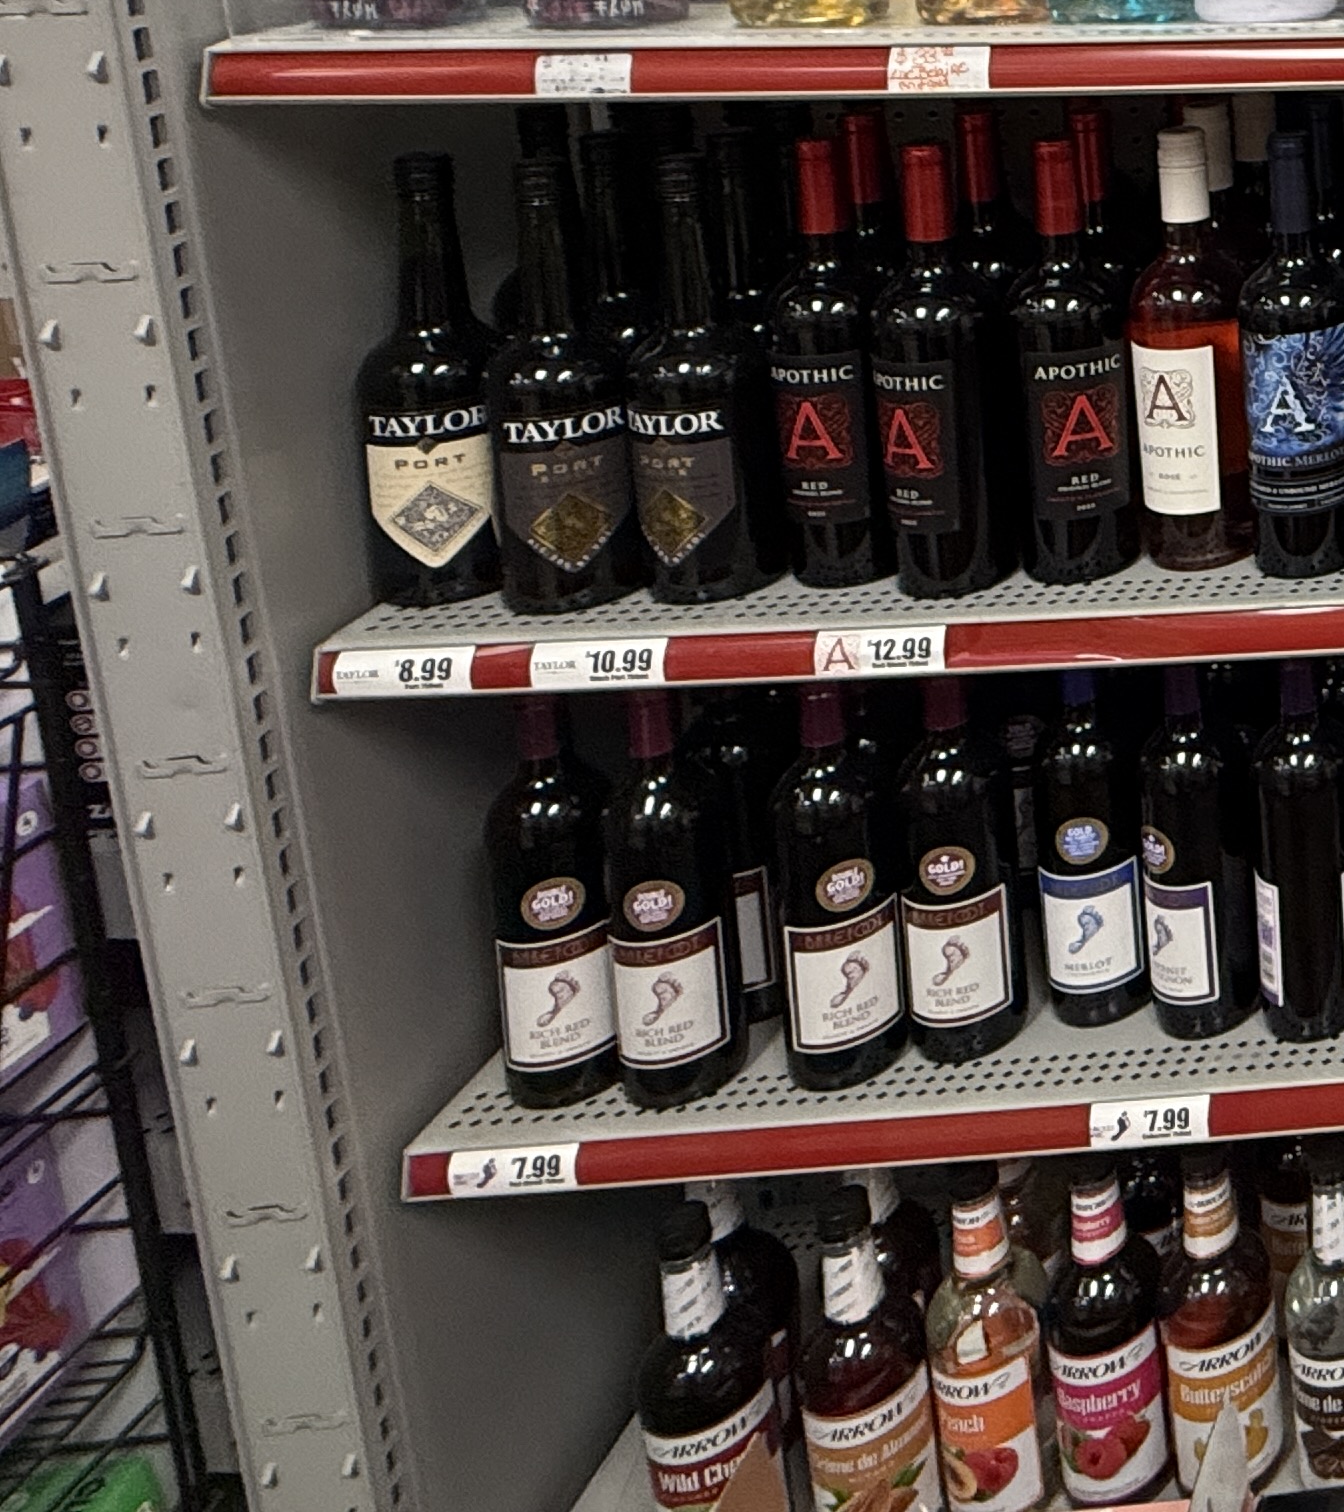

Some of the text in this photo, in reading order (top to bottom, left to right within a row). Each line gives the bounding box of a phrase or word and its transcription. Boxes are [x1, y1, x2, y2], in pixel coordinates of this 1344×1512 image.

[770, 363, 855, 384] APOTHIC
[1034, 354, 1121, 382] APOTHIC
[368, 404, 487, 438] TAYLOR
[502, 405, 625, 444] TAYLOR
[785, 400, 845, 461] A
[1051, 393, 1114, 459] A
[394, 454, 466, 471] PORT
[530, 455, 604, 477] PORT
[1064, 956, 1113, 973] MERLOT
[1056, 1378, 1142, 1415] Raspberry
[1321, 1391, 1341, 1411] de
[658, 1465, 697, 1495] Wild
